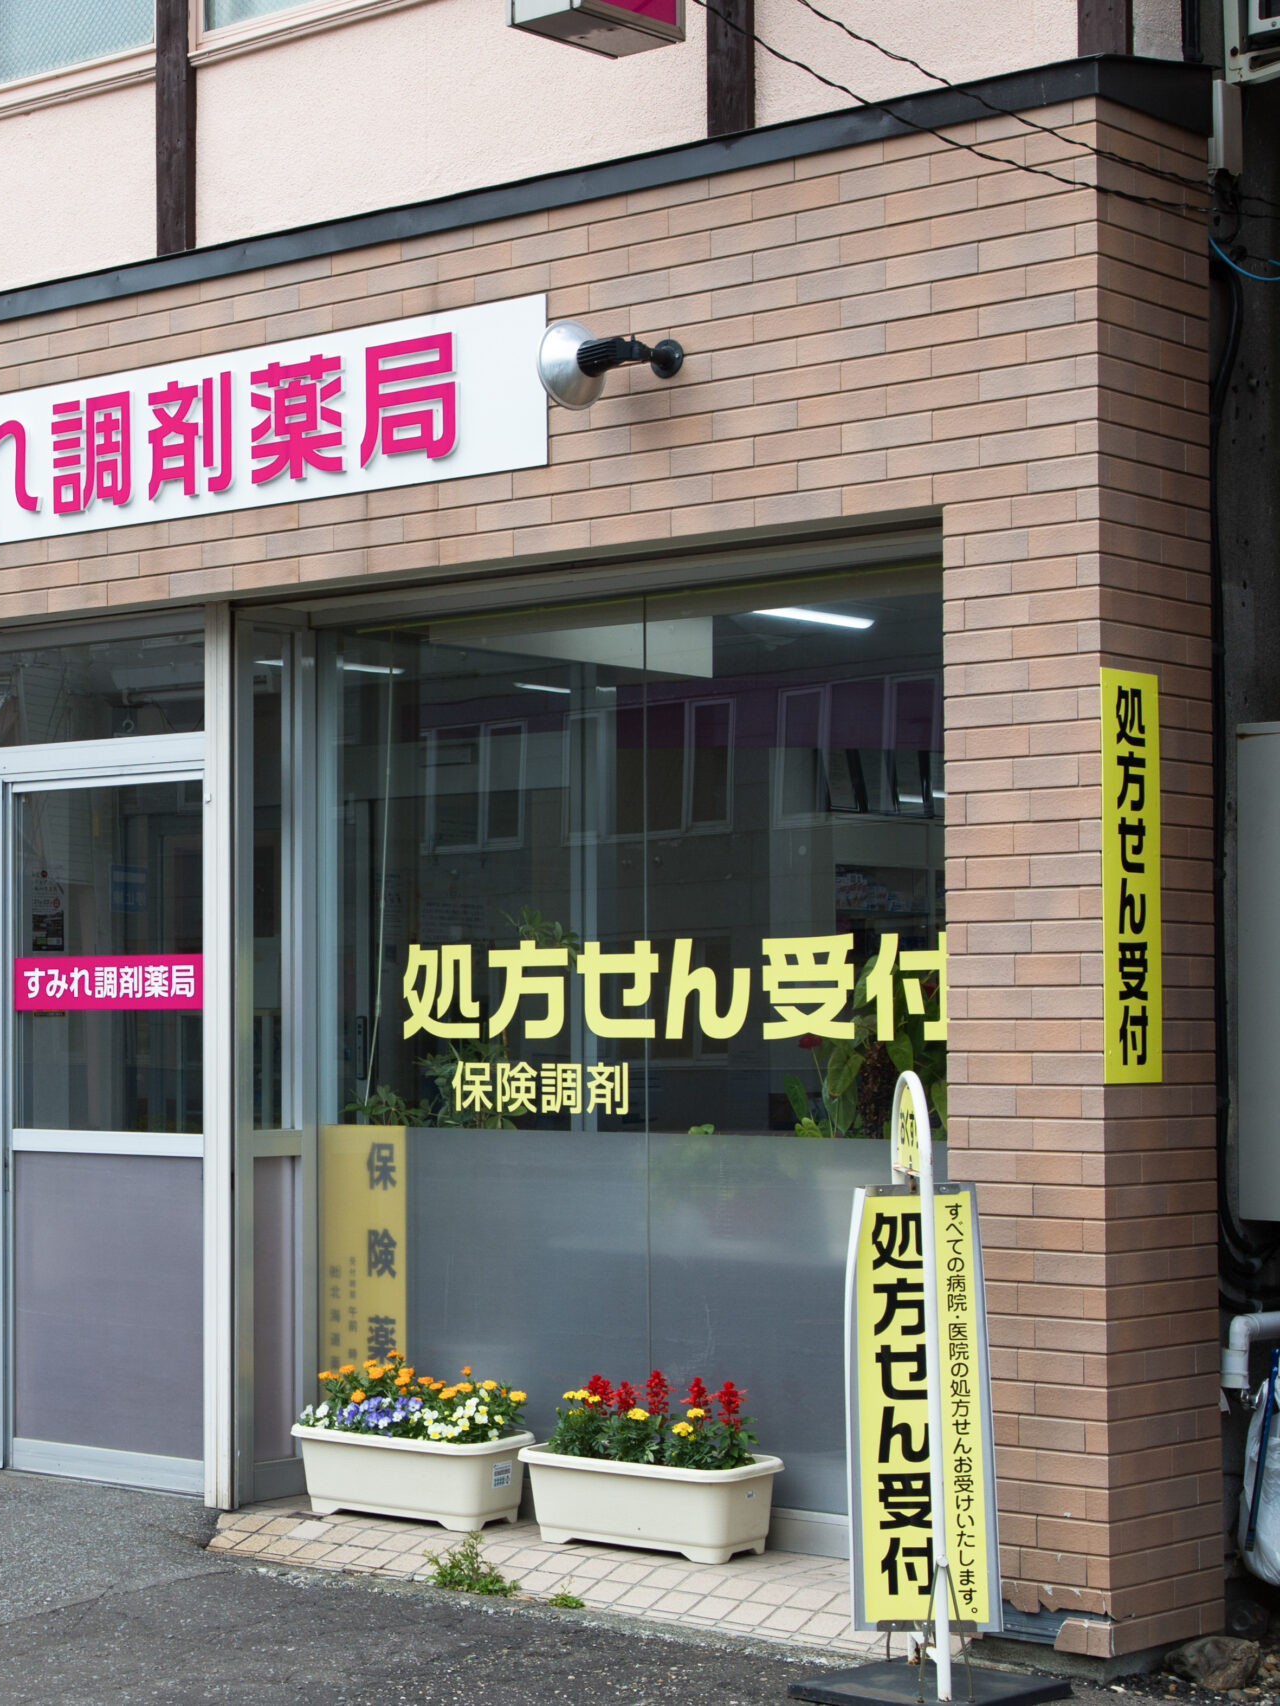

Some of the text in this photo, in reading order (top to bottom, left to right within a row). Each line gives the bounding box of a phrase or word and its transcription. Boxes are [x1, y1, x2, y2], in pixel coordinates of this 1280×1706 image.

[23, 965, 195, 999] すみれ調剤薬局
[403, 932, 948, 1041] 処方せん受付
[1115, 685, 1149, 1066] 処方せん受付
[451, 1061, 630, 1115] 保険調剤
[872, 1212, 933, 1595] 処方せん受付
[945, 1203, 978, 1614] すべての病院・医院の処方せんお受けいたします。
